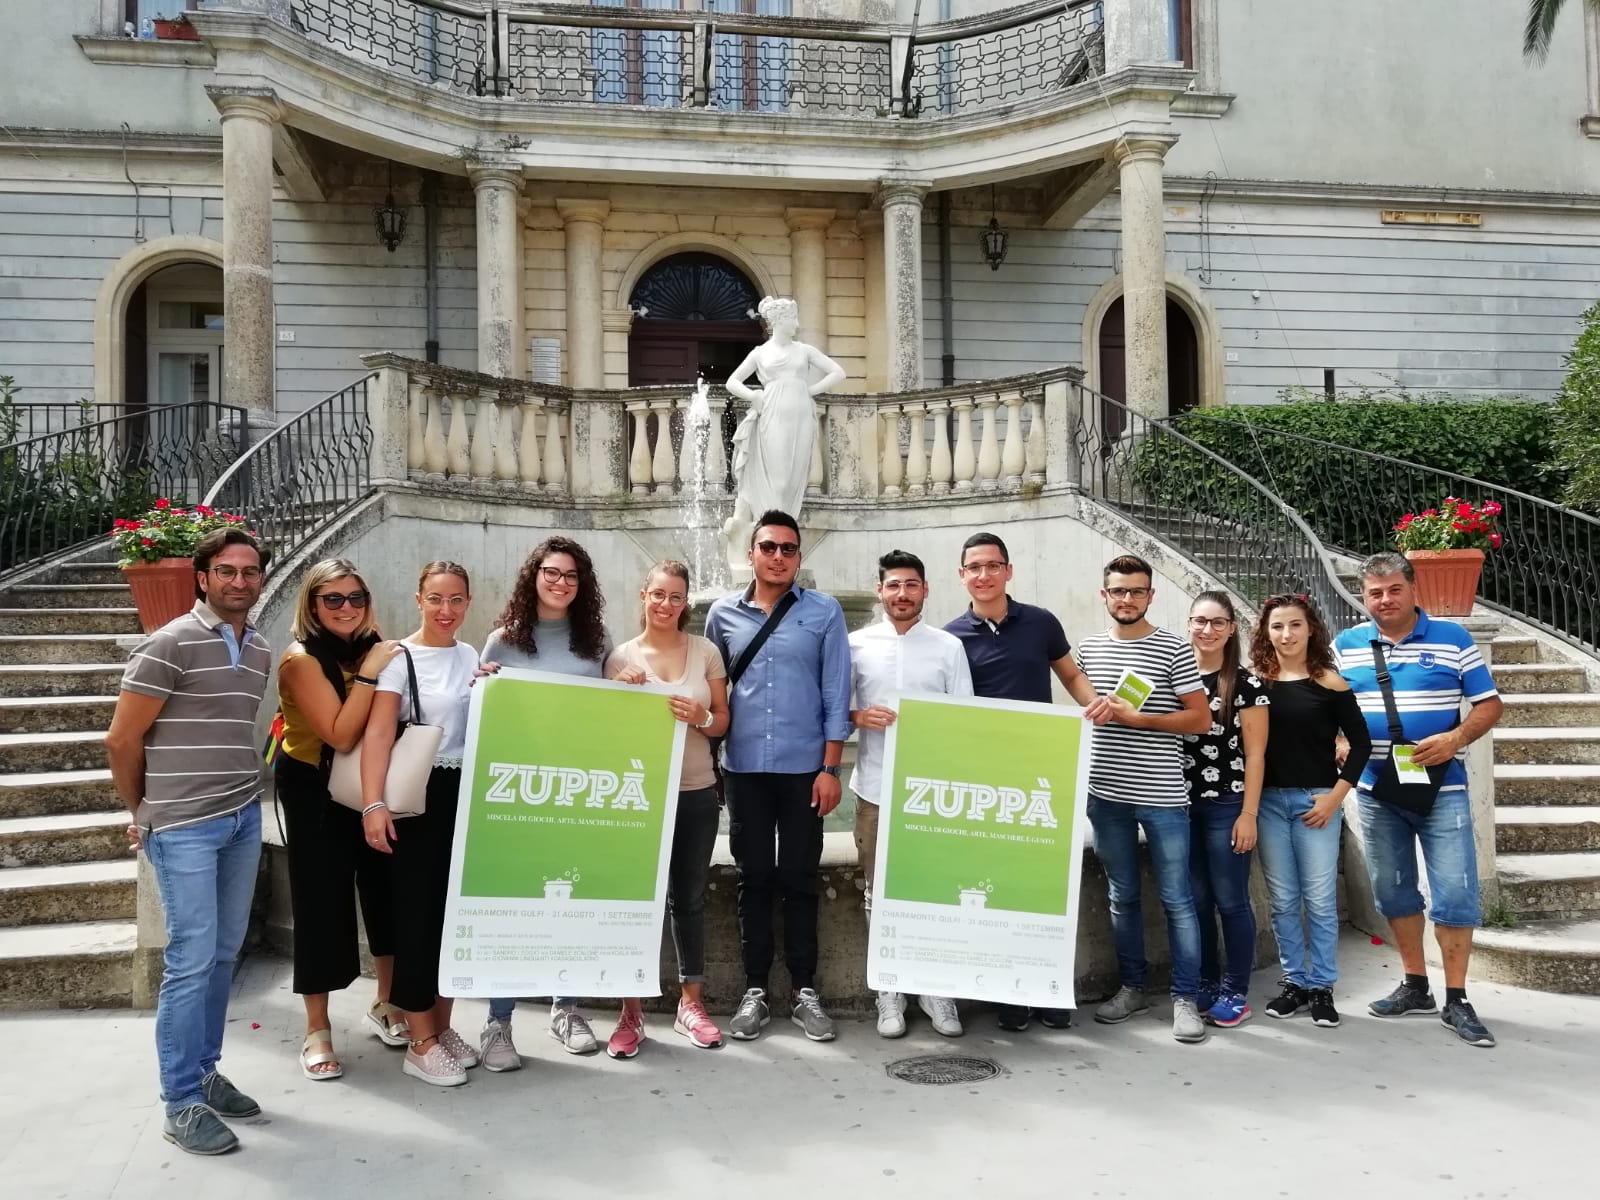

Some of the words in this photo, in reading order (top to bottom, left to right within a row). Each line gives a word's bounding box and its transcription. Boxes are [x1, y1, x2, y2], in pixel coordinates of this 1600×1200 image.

[485, 758, 650, 811] ZUPPÀ
[903, 777, 1058, 828] ZUPPÀ
[486, 813, 517, 822] MISCELA
[577, 818, 615, 827] MASCHERE
[621, 820, 647, 829] GUSTO
[904, 823, 932, 833] MISCELA
[458, 908, 518, 918] CHIARAMONTE
[521, 910, 545, 918] GULFI
[562, 911, 595, 919] AGOSTO
[607, 911, 654, 920] SETTEMBRE
[882, 910, 936, 922] CHIARAMONTE
[977, 919, 1009, 928] AGOSTO
[455, 924, 473, 939] 31
[880, 925, 896, 938] 31
[453, 948, 472, 962] 01
[879, 946, 896, 959] 01
